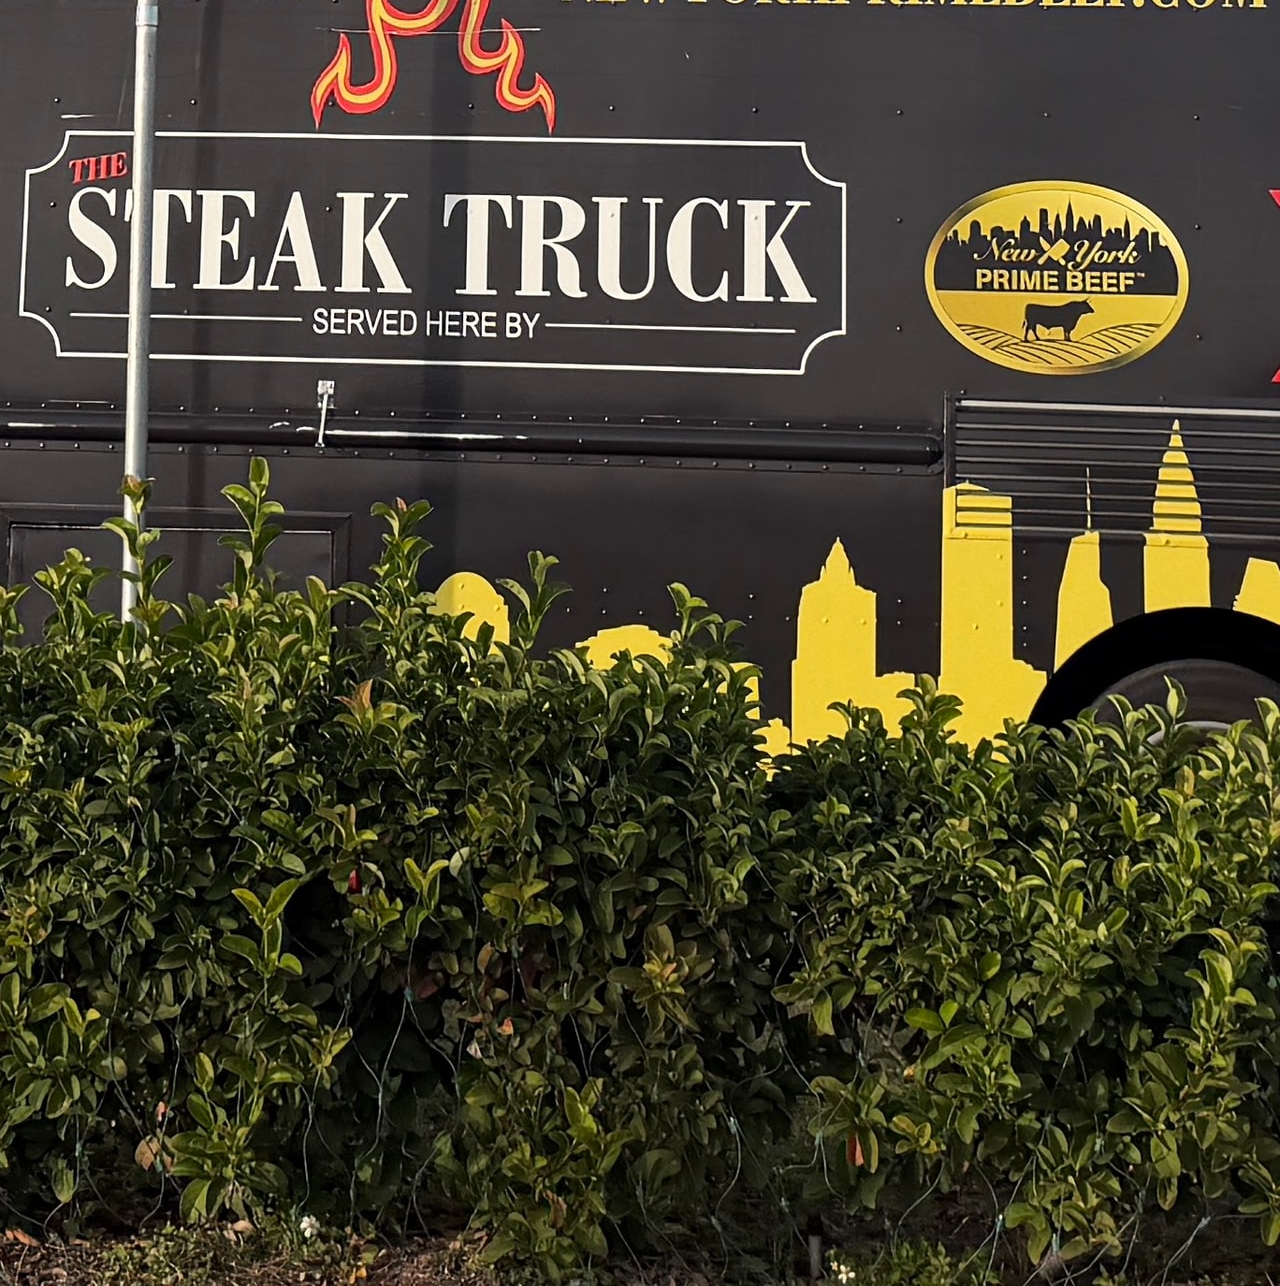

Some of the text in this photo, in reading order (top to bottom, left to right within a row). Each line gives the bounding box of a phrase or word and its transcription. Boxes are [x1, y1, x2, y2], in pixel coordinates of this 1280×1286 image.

[69, 152, 128, 184] THE
[66, 187, 817, 303] STEAK TRUCK
[973, 237, 1142, 271] New York
[976, 269, 1059, 291] PRIME
[312, 308, 541, 339] SERVED HERE BY
